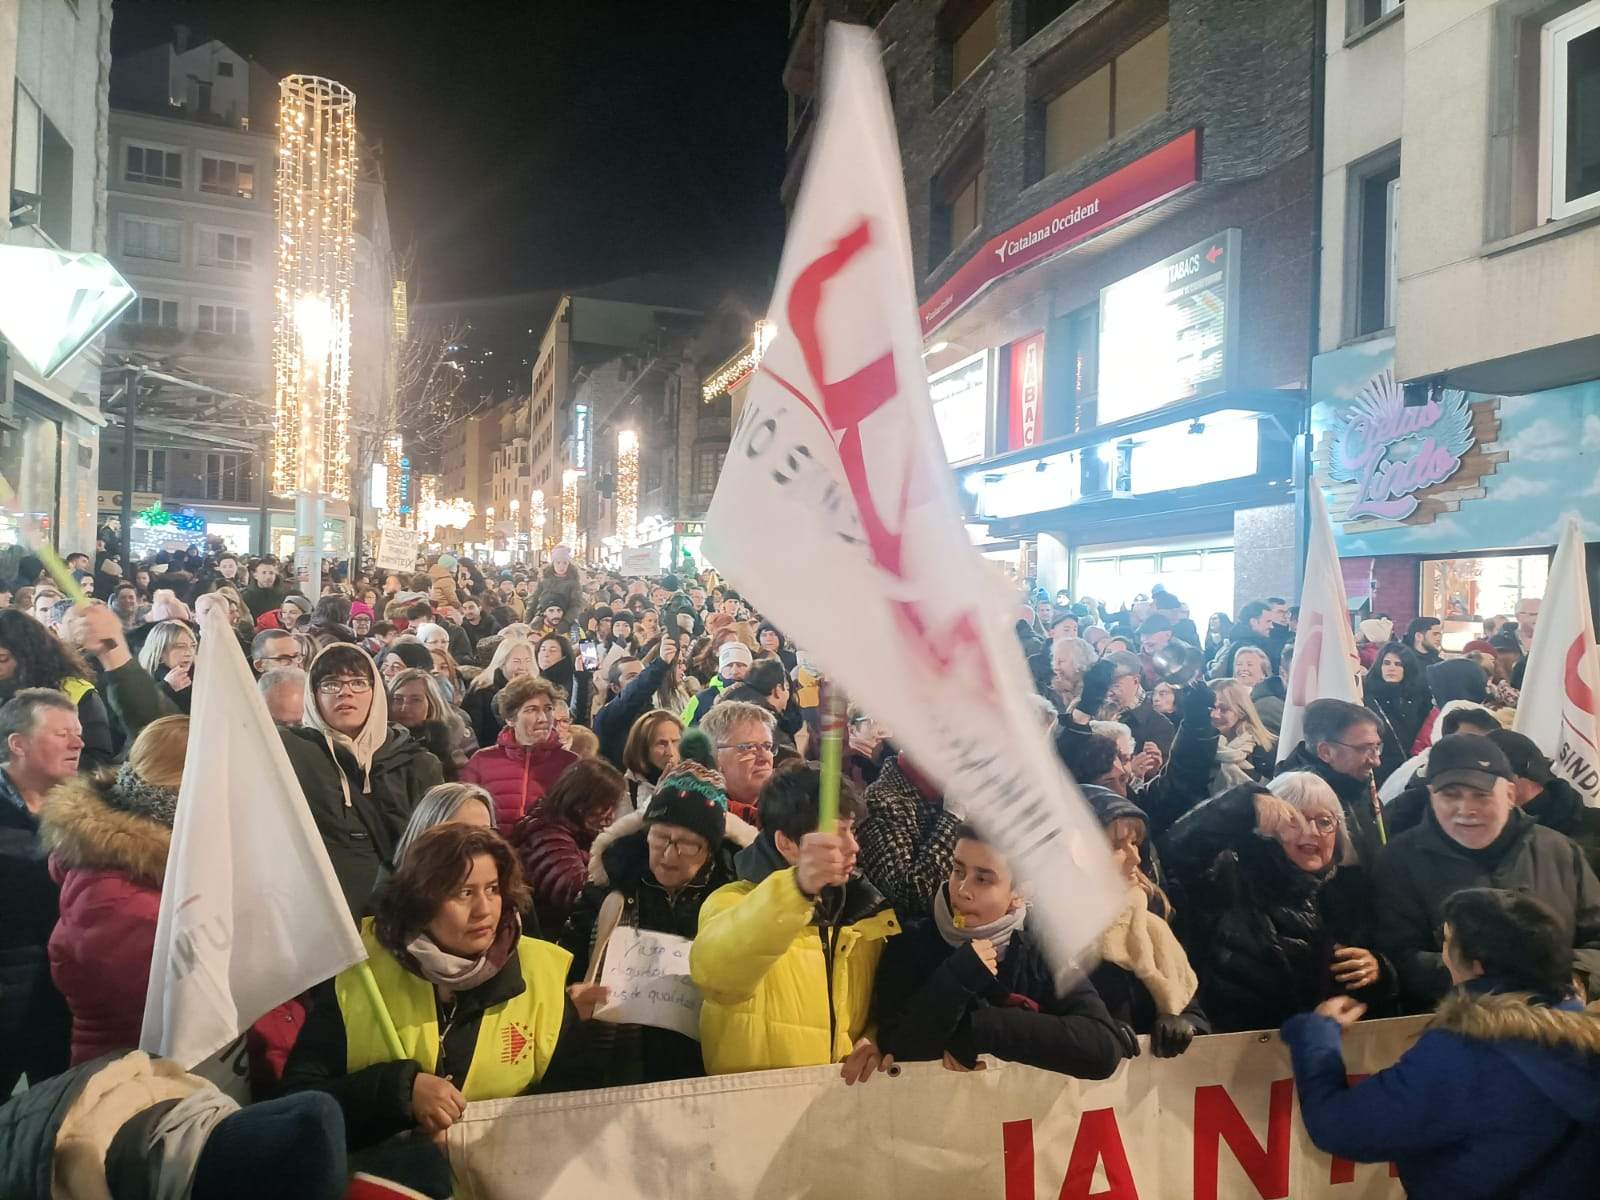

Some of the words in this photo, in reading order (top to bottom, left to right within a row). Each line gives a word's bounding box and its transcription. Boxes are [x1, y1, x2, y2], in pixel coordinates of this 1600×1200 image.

[1007, 226, 1051, 256] Catalana
[1051, 198, 1100, 234] Occident
[1024, 346, 1036, 445] TABAC
